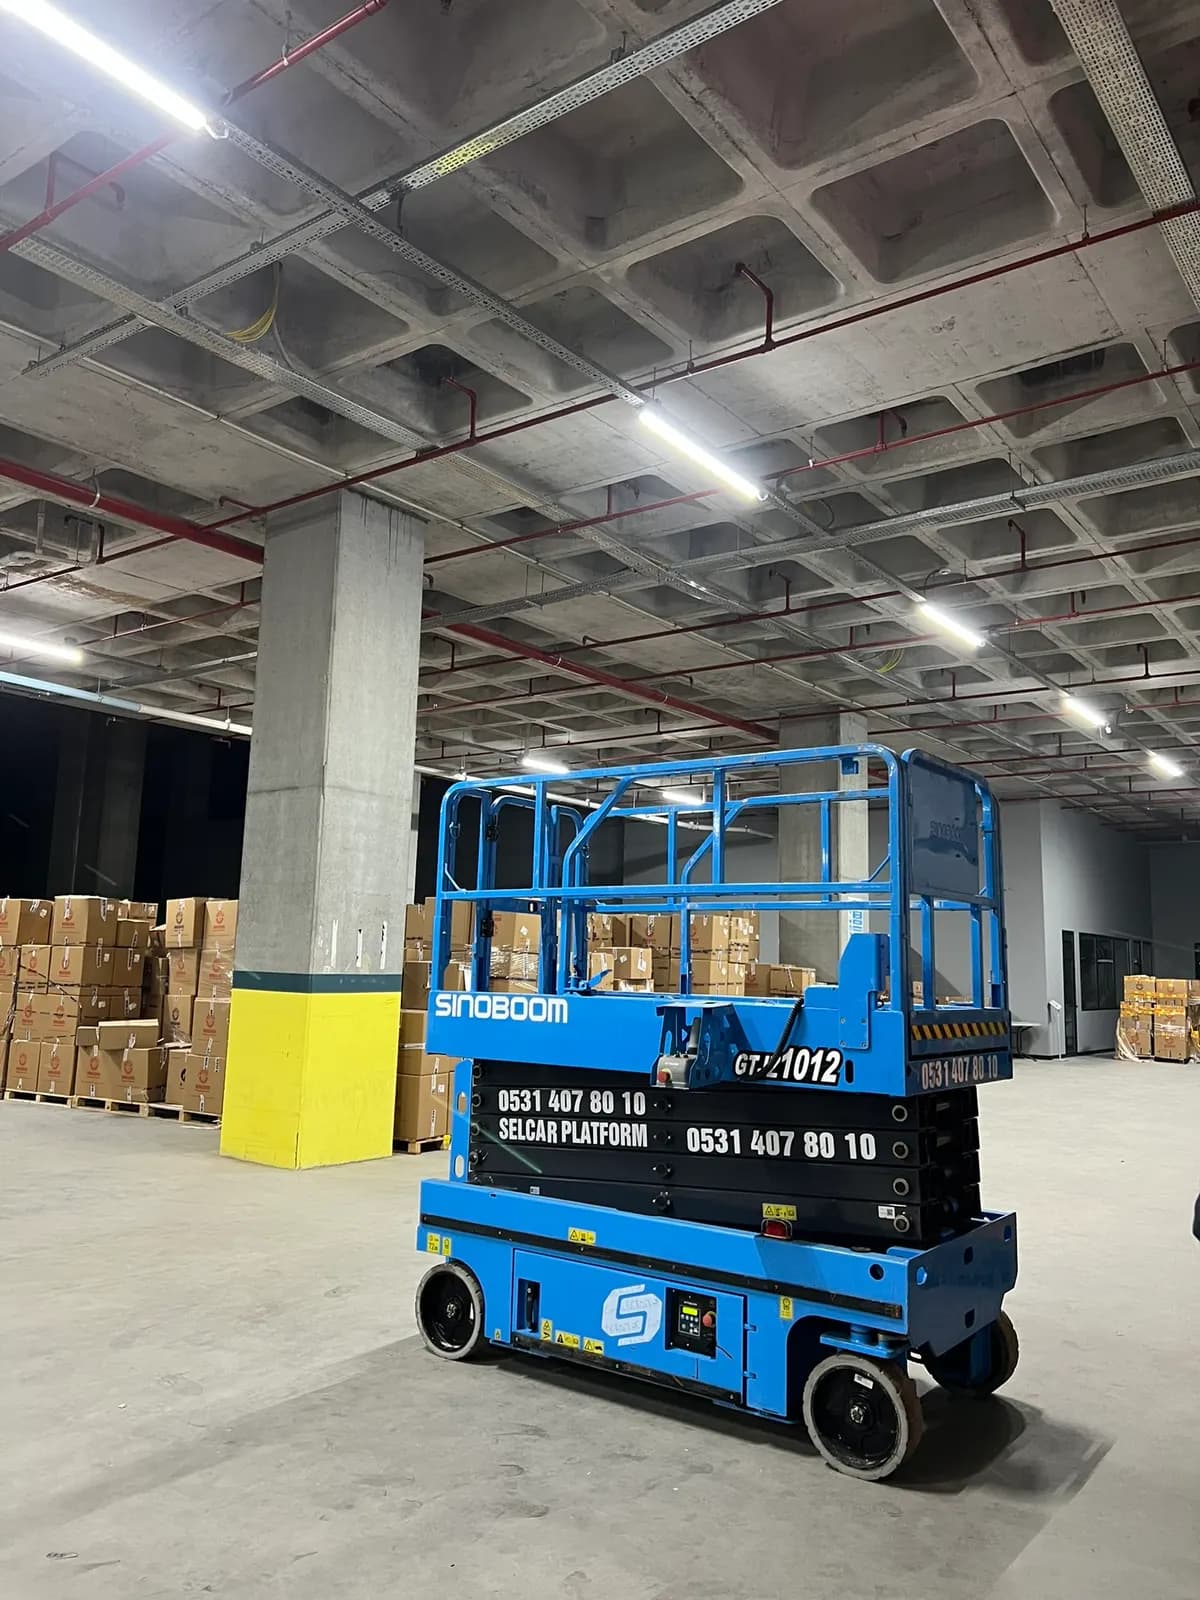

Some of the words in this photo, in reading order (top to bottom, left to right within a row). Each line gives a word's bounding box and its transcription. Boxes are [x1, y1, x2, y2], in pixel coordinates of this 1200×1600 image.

[435, 993, 568, 1024] SINOBOOM
[922, 1060, 949, 1090] 0531
[952, 1056, 970, 1084] 407
[972, 1055, 985, 1081] 80
[987, 1054, 998, 1079] 10
[498, 1089, 541, 1112] 0531
[548, 1089, 584, 1113] 407
[589, 1090, 615, 1114] 80
[622, 1091, 646, 1116] 10
[498, 1117, 558, 1144] SELCAR
[561, 1120, 648, 1148] PLATFORM
[686, 1127, 741, 1154] 0531
[750, 1129, 795, 1157] 407
[803, 1131, 835, 1159] 80
[844, 1132, 877, 1161] 10
